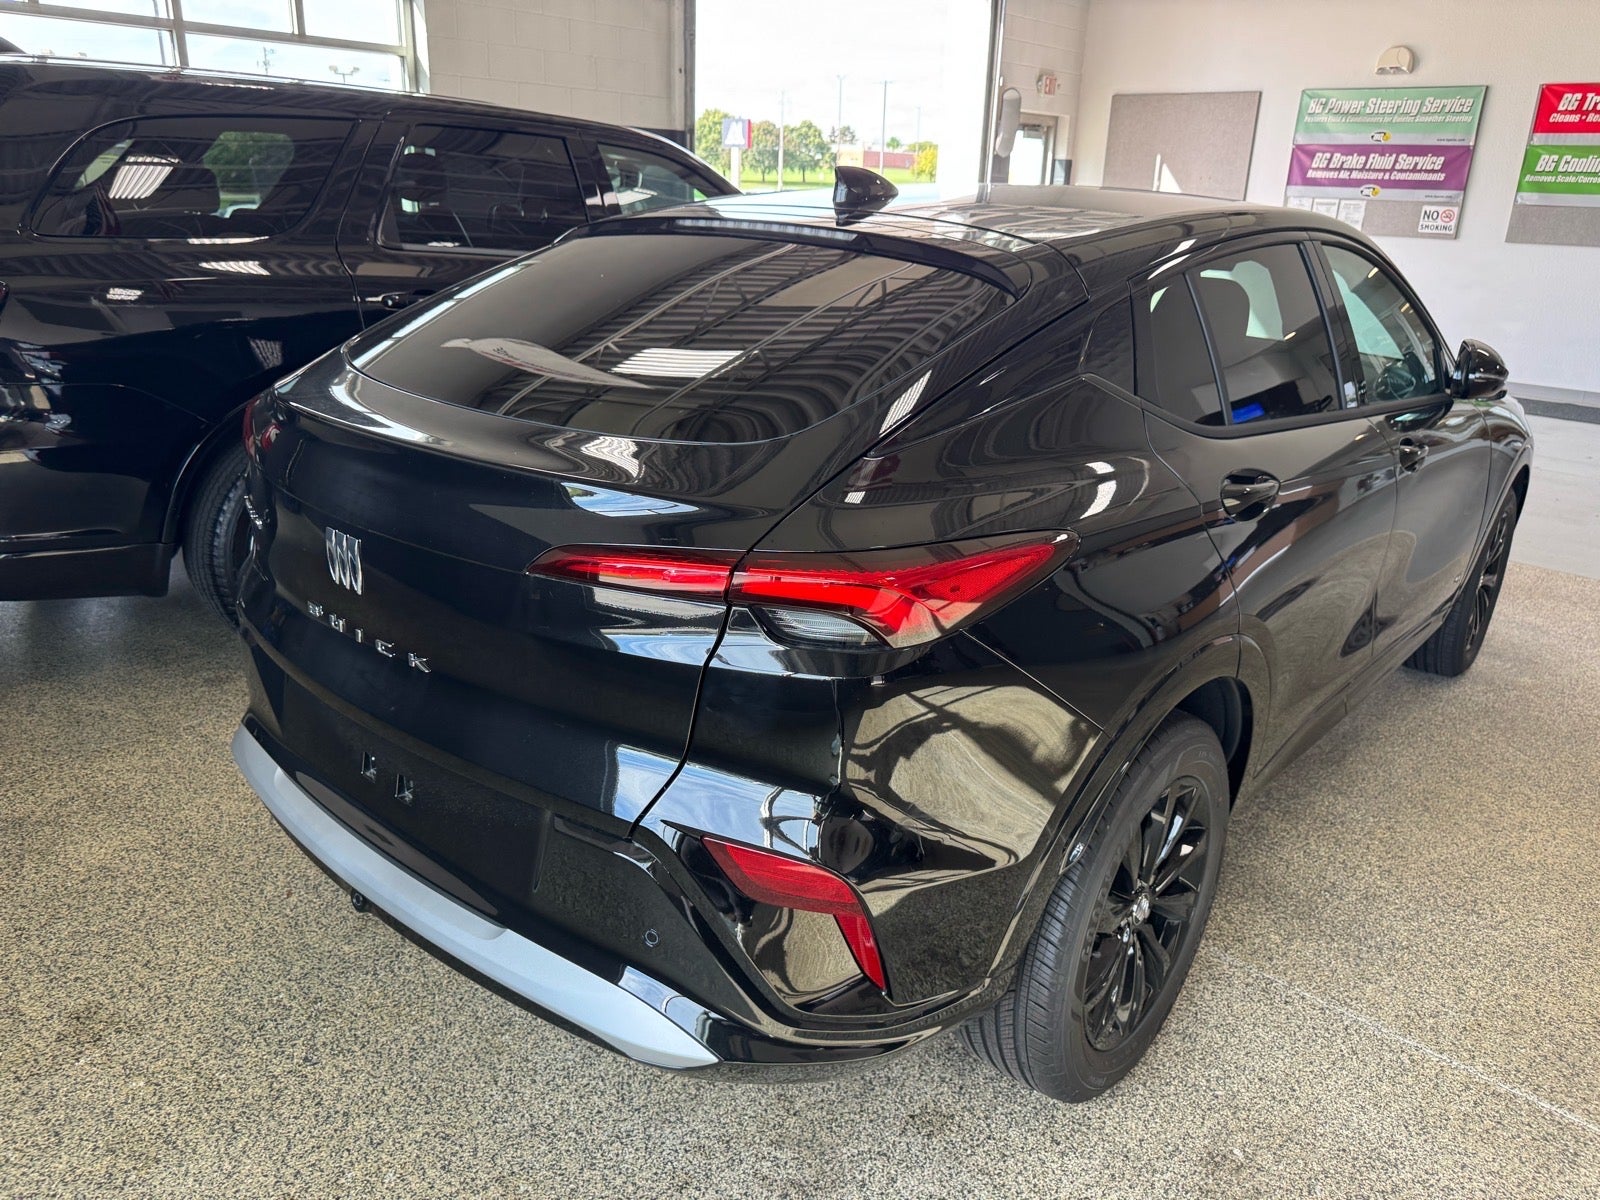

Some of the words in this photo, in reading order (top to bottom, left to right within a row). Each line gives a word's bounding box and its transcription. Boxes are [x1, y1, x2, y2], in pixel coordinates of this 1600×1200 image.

[1307, 97, 1326, 115] BG
[1326, 97, 1365, 115] Power
[1366, 96, 1421, 117] Steering
[1422, 96, 1473, 114] Service
[1557, 93, 1582, 111] BG
[1445, 115, 1472, 123] Steering
[1549, 113, 1581, 123] Cleans
[1311, 153, 1331, 169] BG
[1329, 153, 1366, 169] Brake
[1365, 153, 1396, 170] Fluid
[1395, 153, 1445, 170] Service
[1535, 154, 1559, 172] BG
[1306, 169, 1339, 179] Removes
[1350, 170, 1383, 180] Moisture
[1390, 171, 1446, 182] Contaminants
[1525, 174, 1556, 183] Removes
[1423, 210, 1440, 221] NO
[1420, 224, 1453, 232] SMOKING
[307, 600, 431, 673] BUICK
